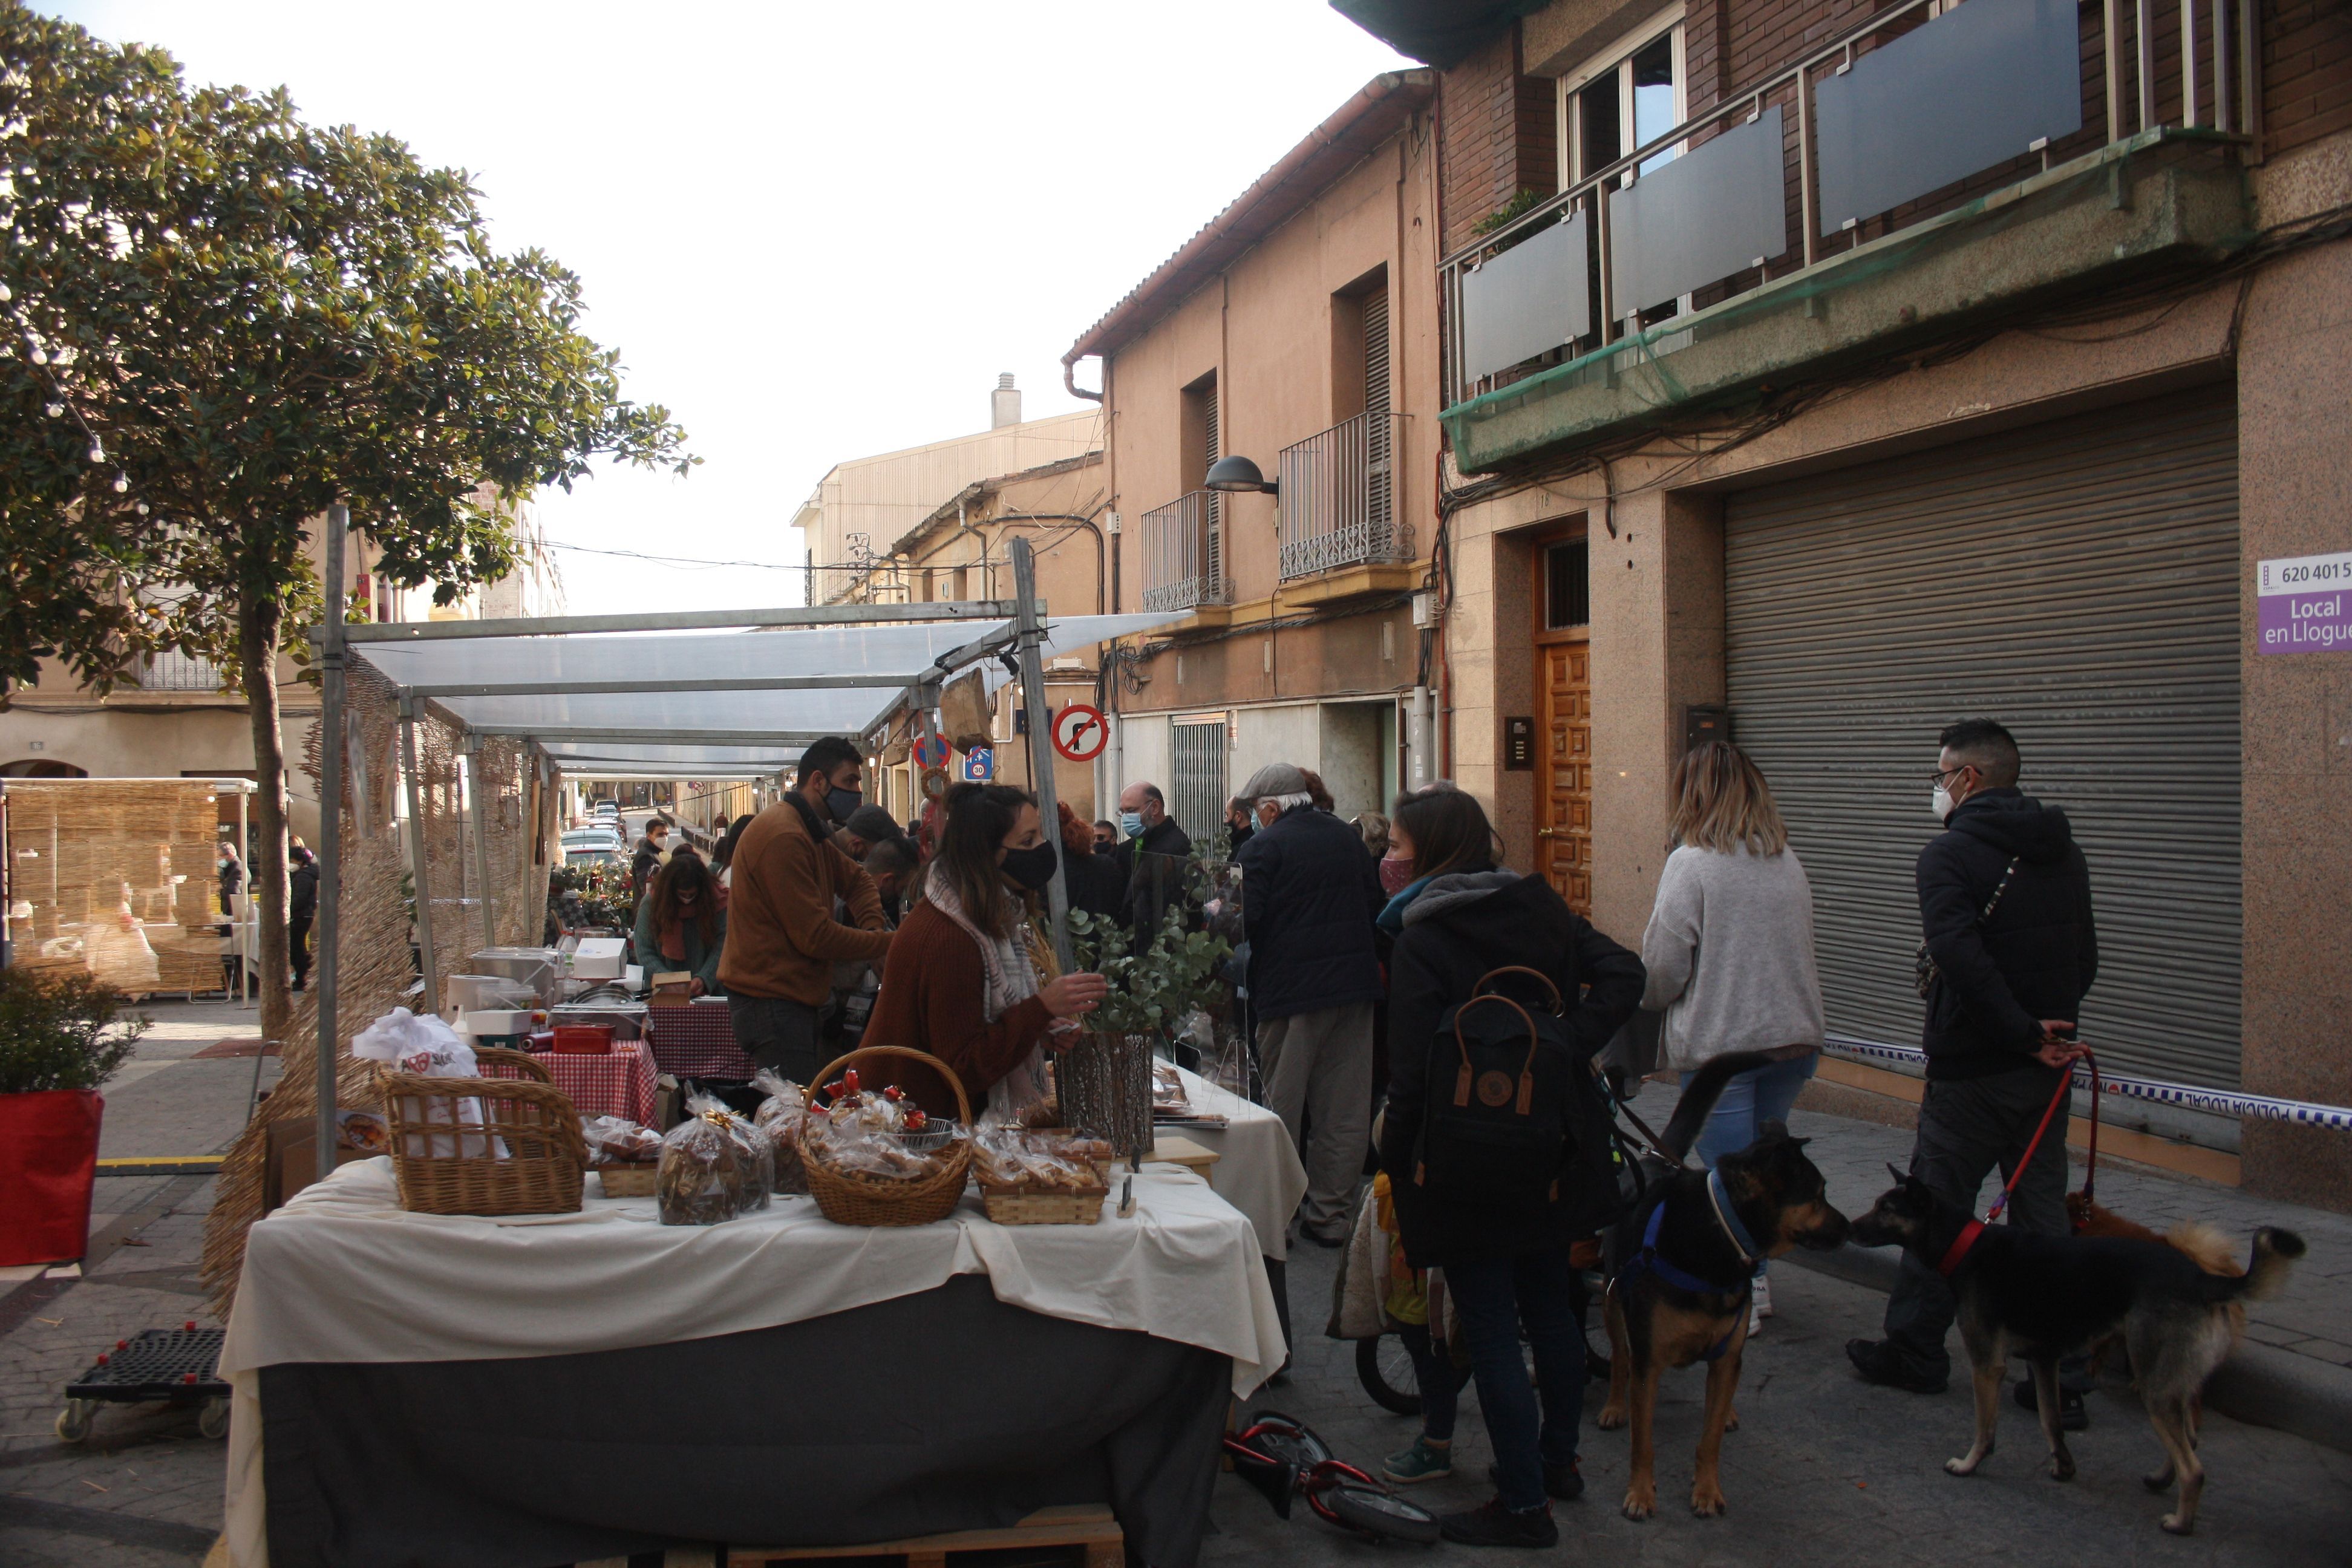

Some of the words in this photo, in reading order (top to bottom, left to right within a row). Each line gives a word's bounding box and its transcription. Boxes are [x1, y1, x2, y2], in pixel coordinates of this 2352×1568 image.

[1541, 492, 1549, 508] 18
[2282, 566, 2309, 583] 620
[2312, 563, 2339, 580] 401
[2291, 595, 2341, 619] Local
[2265, 627, 2288, 644] en
[2185, 1094, 2229, 1112] LOCAL
[2233, 1100, 2290, 1125] POLICIA
